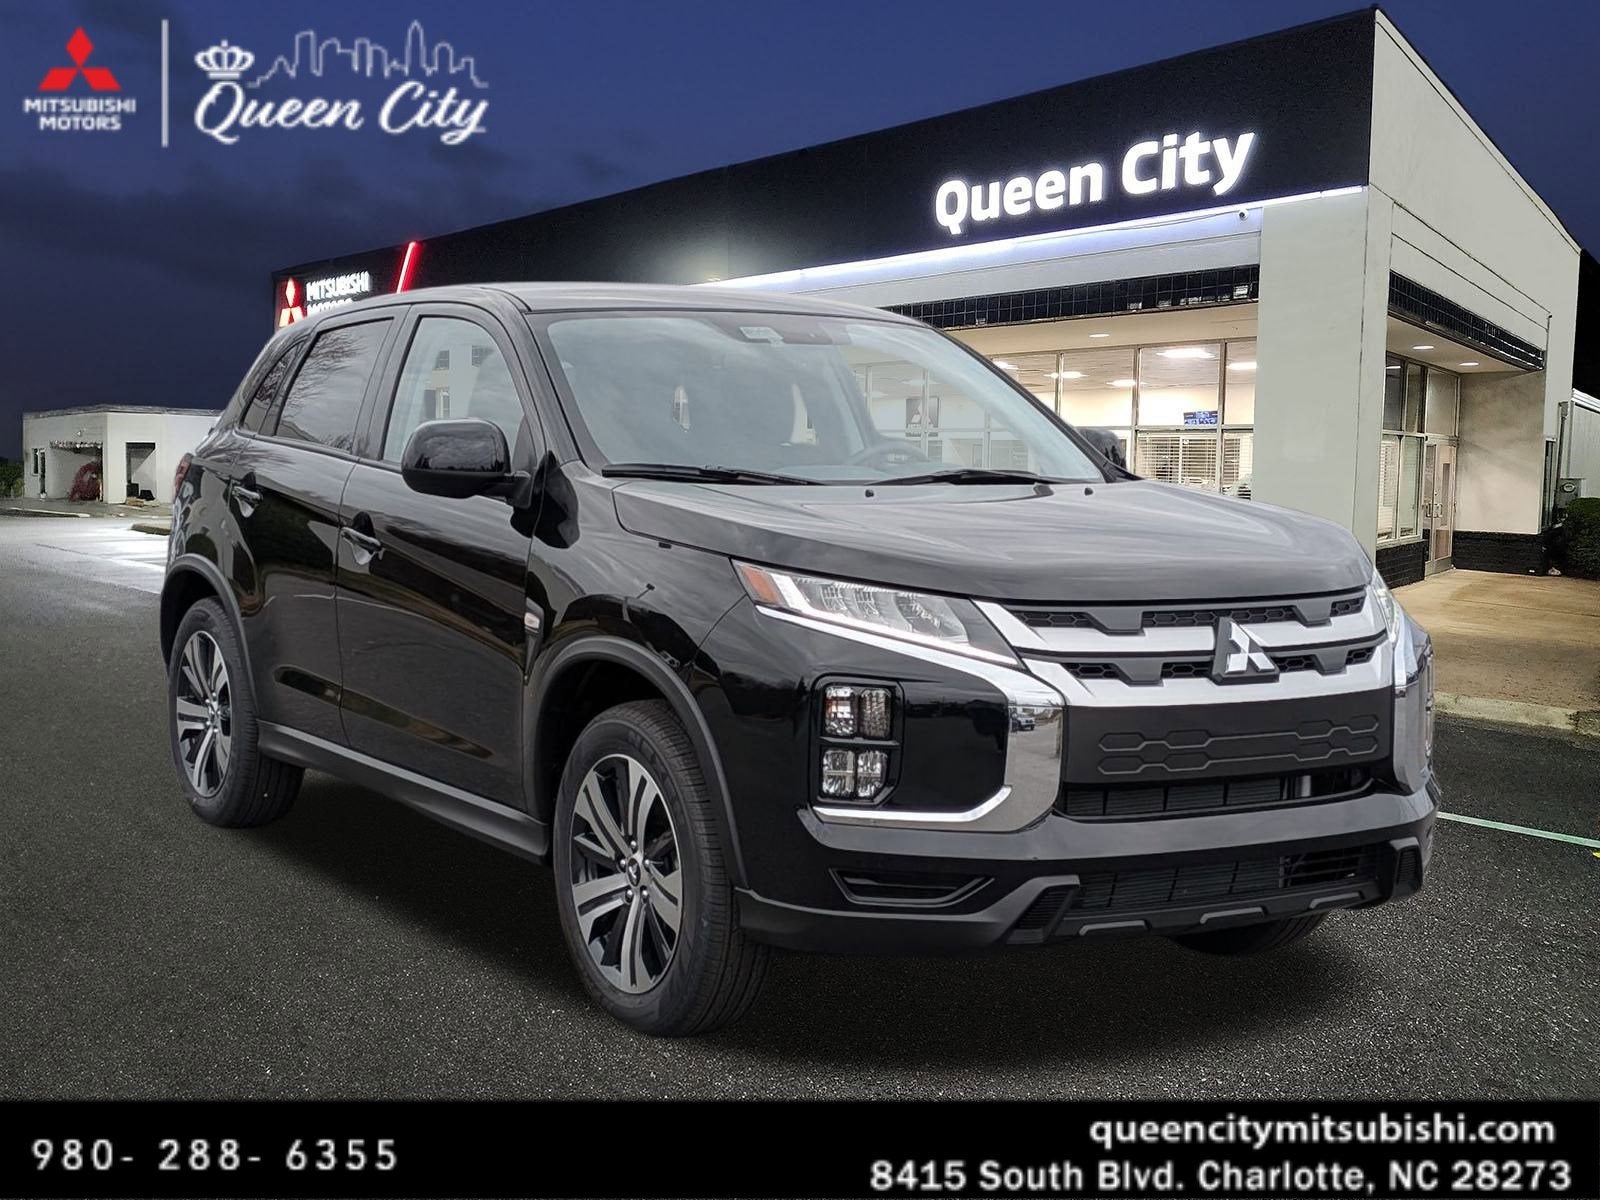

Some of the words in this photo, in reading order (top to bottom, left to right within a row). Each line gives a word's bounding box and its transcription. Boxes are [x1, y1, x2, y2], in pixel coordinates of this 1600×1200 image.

[935, 162, 1104, 235] Queen
[1121, 132, 1256, 195] City
[306, 271, 370, 301] MITSUBISHI
